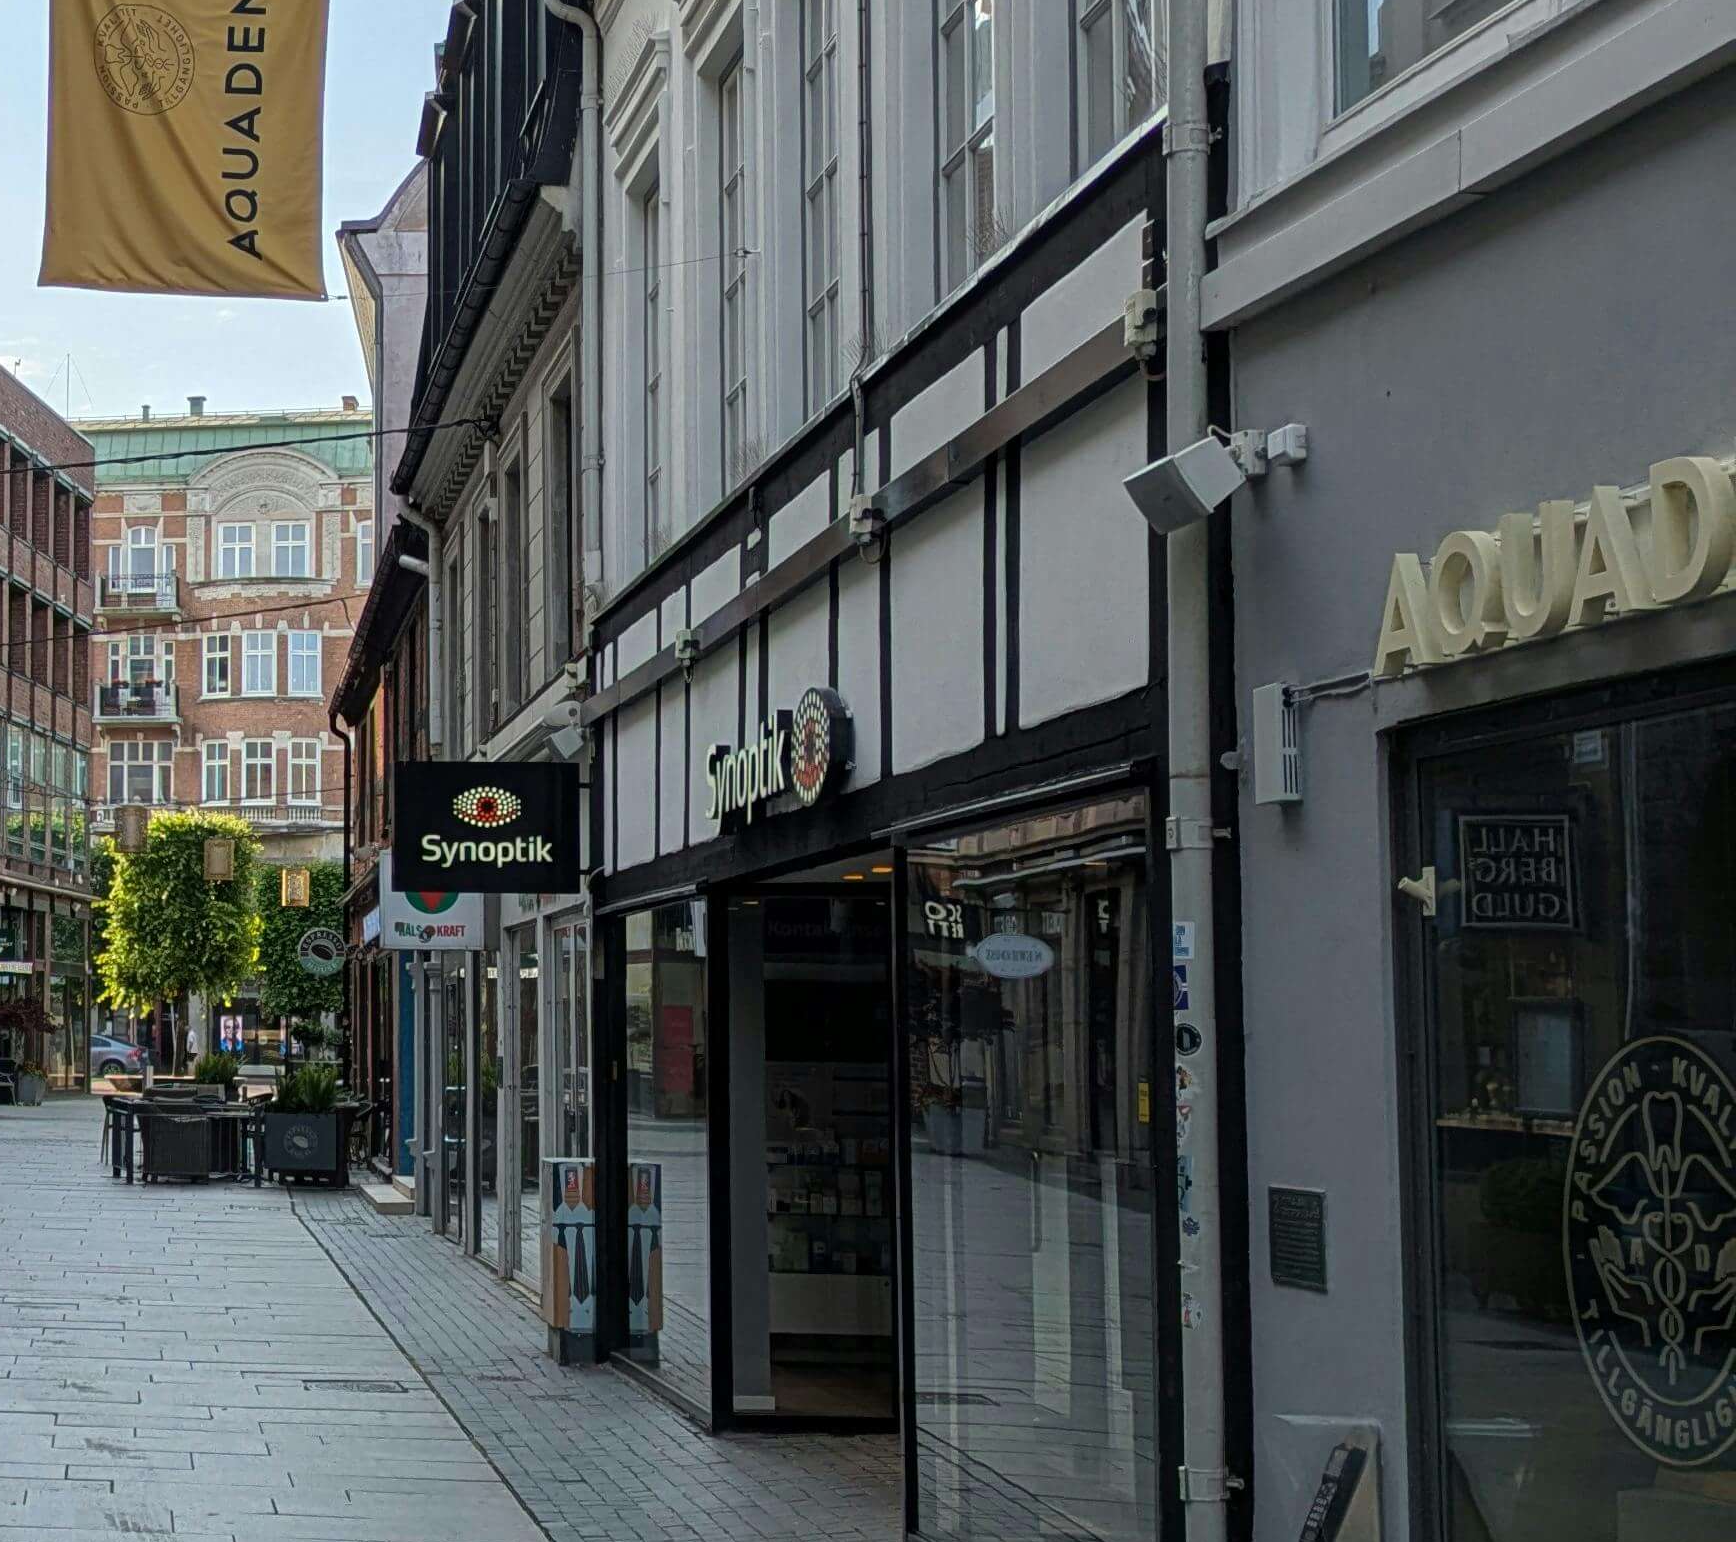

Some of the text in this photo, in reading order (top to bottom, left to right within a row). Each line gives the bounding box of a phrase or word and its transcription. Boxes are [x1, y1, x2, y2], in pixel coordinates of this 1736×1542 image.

[1373, 456, 1736, 677] AQUAD
[705, 710, 785, 837] Synoptik
[421, 834, 553, 868] Synoptik
[1572, 1061, 1642, 1222] PASSION
